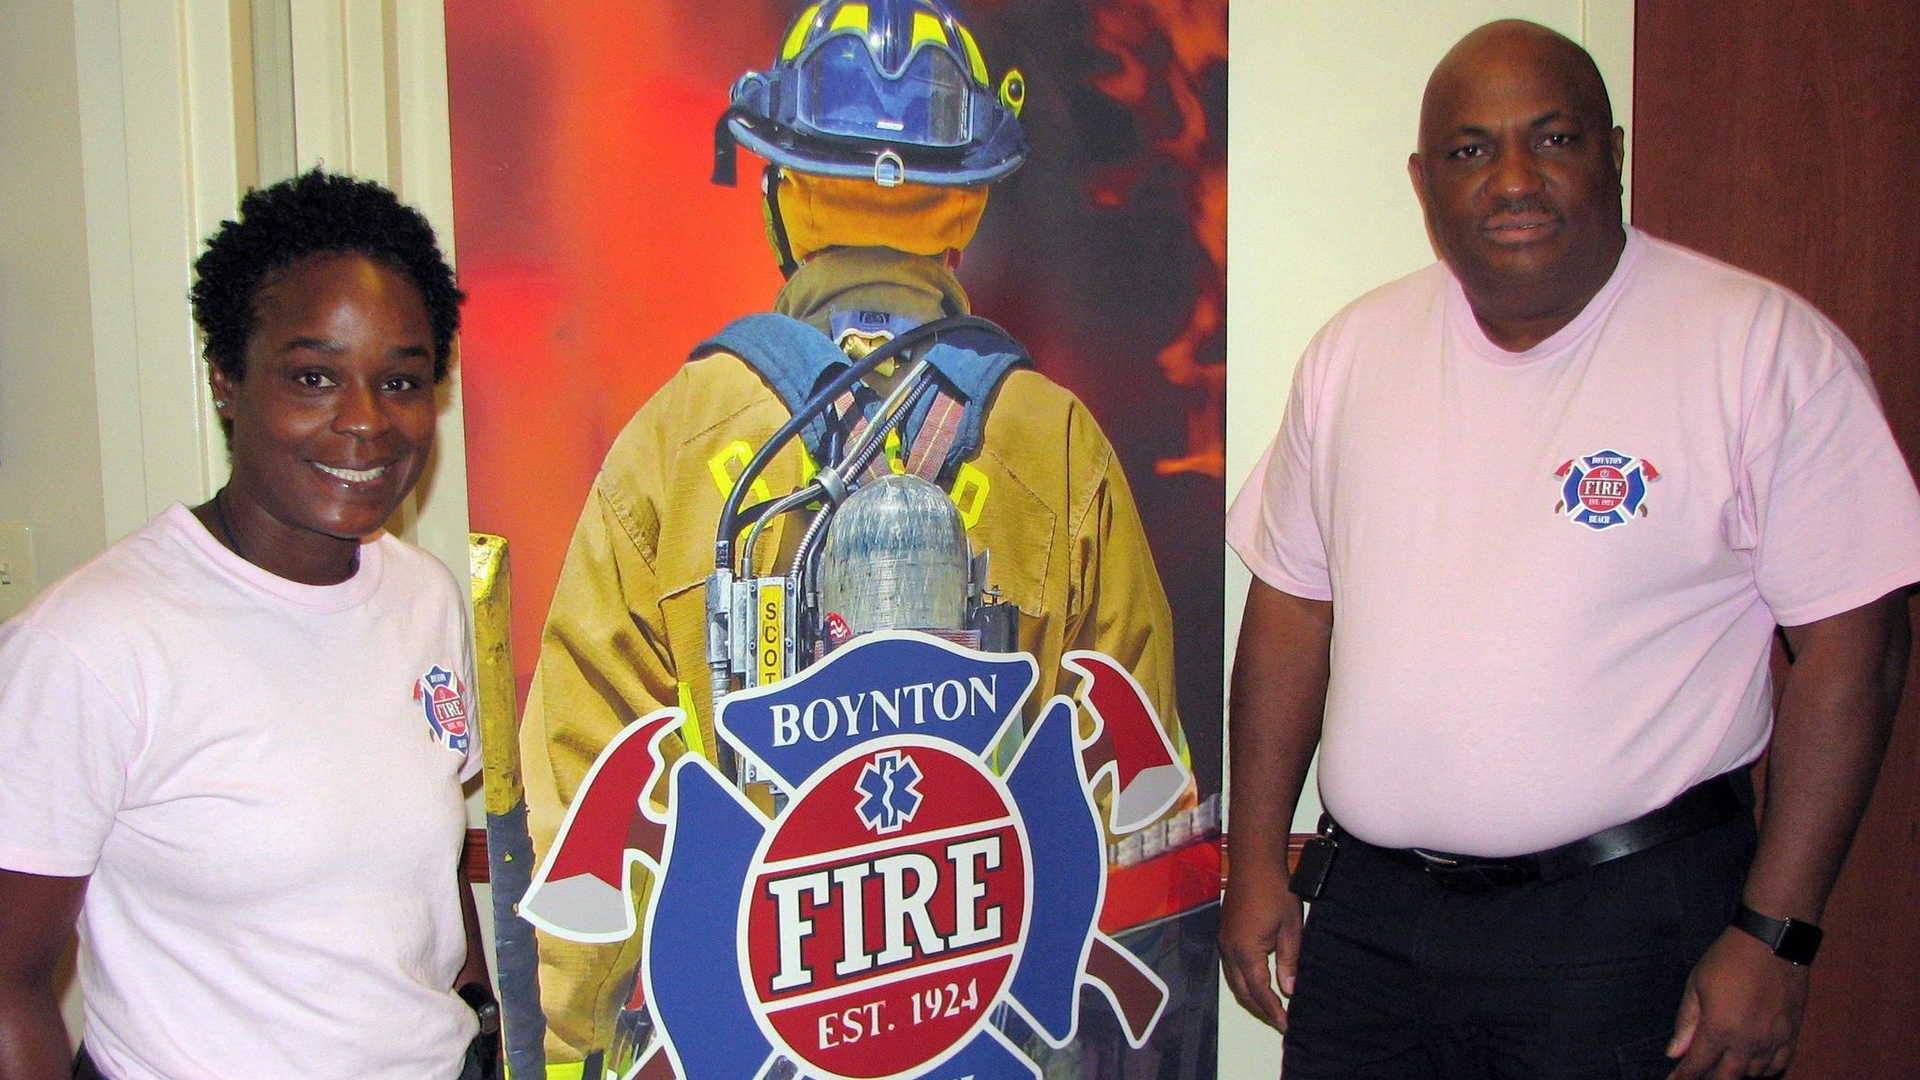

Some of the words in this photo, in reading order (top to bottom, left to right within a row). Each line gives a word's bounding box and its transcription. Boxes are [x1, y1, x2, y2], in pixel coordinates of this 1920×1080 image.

[1584, 481, 1622, 496] FIRE
[436, 700, 463, 719] FIRE
[769, 674, 997, 748] BOYNTON
[768, 836, 1002, 991] FIRE
[817, 1001, 895, 1050] EST.
[911, 978, 979, 1026] 1924
